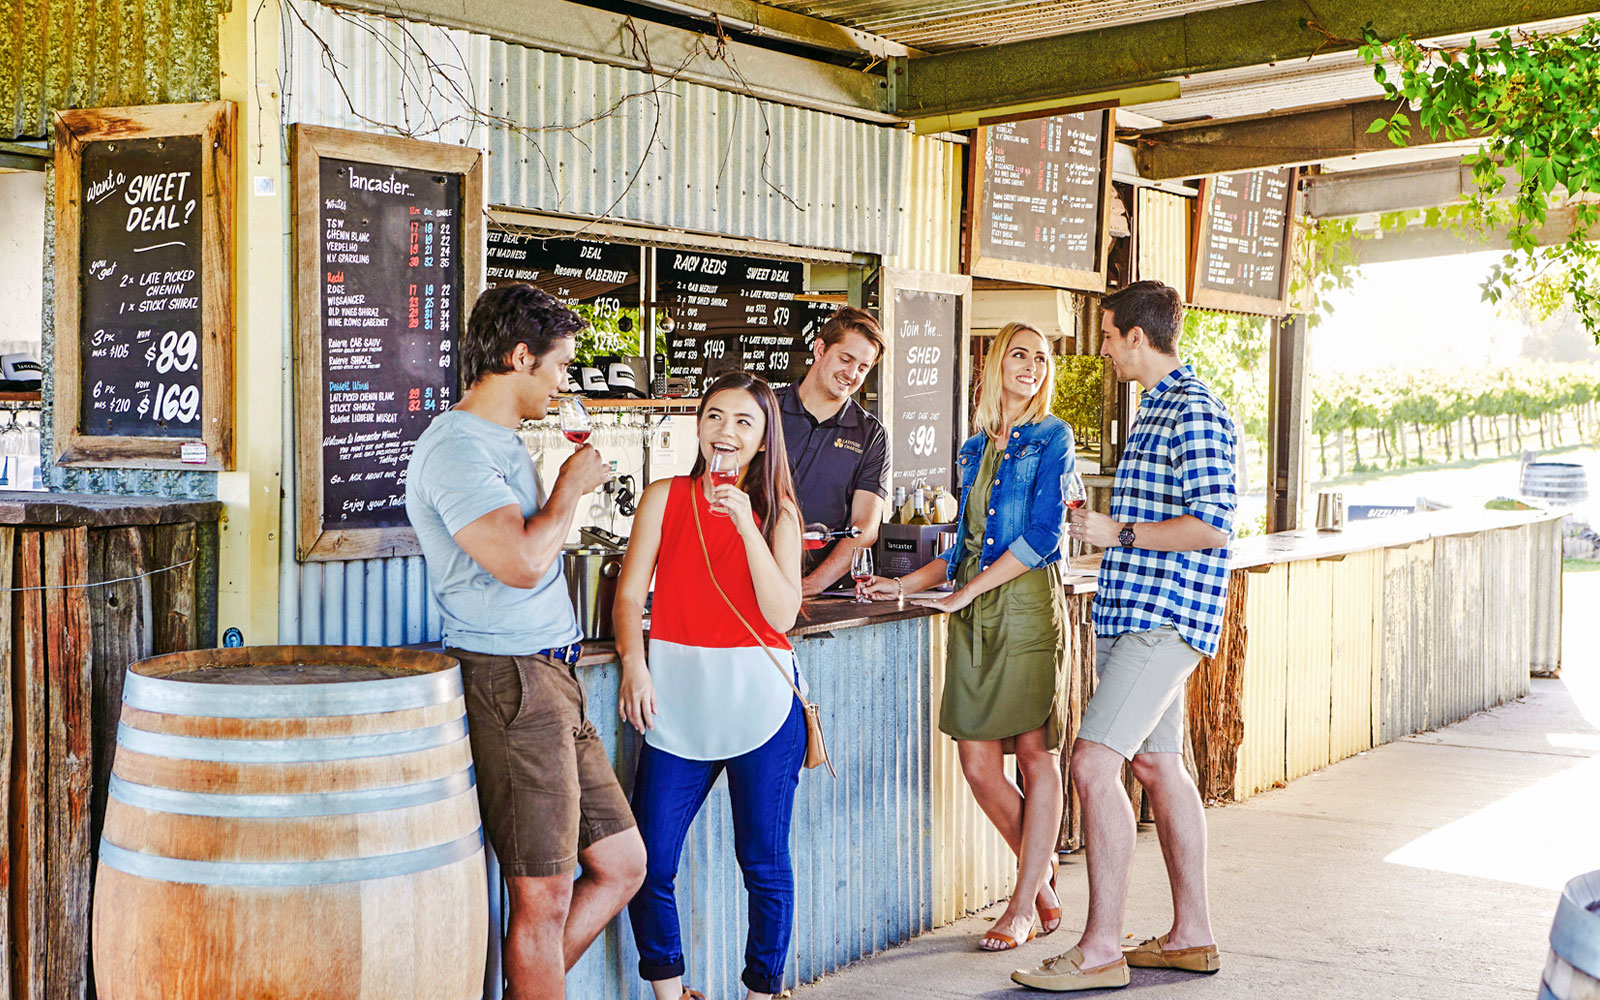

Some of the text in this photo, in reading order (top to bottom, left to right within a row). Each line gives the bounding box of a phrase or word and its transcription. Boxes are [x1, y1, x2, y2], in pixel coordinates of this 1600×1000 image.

[125, 172, 191, 206] SWEET
[126, 199, 196, 232] DEAL?
[410, 221, 419, 233] 17
[440, 223, 450, 235] 22
[326, 230, 370, 242] CHENIN BLANC
[410, 232, 419, 243] 17
[440, 235, 450, 246] 22
[503, 234, 519, 244] DEAL
[424, 244, 433, 255] 21
[440, 246, 450, 257] 24
[496, 248, 527, 260] MADNESS
[580, 246, 602, 260] DEAL
[408, 256, 419, 267] 30
[424, 256, 433, 267] 32
[439, 257, 450, 268] 35
[673, 253, 728, 275] RACY REDS
[89, 259, 107, 276] you
[98, 263, 117, 281] get
[139, 272, 162, 287] LATE
[162, 270, 195, 283] PICKED
[553, 264, 628, 284] Reserve CABERNET
[746, 267, 790, 283] SWEET DEAL
[146, 283, 184, 297] CHENIN
[409, 284, 417, 296] 17
[425, 284, 434, 296] 19
[441, 284, 451, 296] 22
[687, 282, 699, 292] CAB
[750, 290, 762, 298] LATE
[138, 299, 167, 313] STICKY
[168, 297, 199, 311] SHIRAZ
[593, 296, 620, 319] $159
[358, 307, 379, 317] SHIRAZ
[424, 309, 433, 319] 31
[440, 310, 450, 320] 34
[773, 307, 790, 326] $79
[424, 319, 433, 330] 31
[440, 321, 450, 331] 34
[900, 320, 919, 338] Join
[137, 329, 151, 340] NOW
[350, 337, 362, 348] CAB
[749, 336, 761, 345] LATE
[109, 344, 130, 359] $105
[703, 339, 725, 359] $149
[350, 355, 372, 365] SHIRAZ
[768, 351, 789, 370] $139
[906, 346, 941, 365] SHED
[907, 368, 938, 386] CLUB
[135, 380, 150, 390] NOW
[329, 392, 395, 402] LATE PICKED CHENIN BLANC
[424, 387, 433, 398] 31
[440, 387, 450, 398] 34
[109, 397, 131, 413] $210
[329, 402, 376, 413] STICKY SHIRAZ
[424, 400, 436, 411] 34
[376, 412, 398, 423] MUSCAT
[349, 473, 362, 482] ASK
[365, 471, 384, 480] ABOUT
[342, 498, 387, 512] Enjoy your
[888, 541, 913, 550] lancaster
